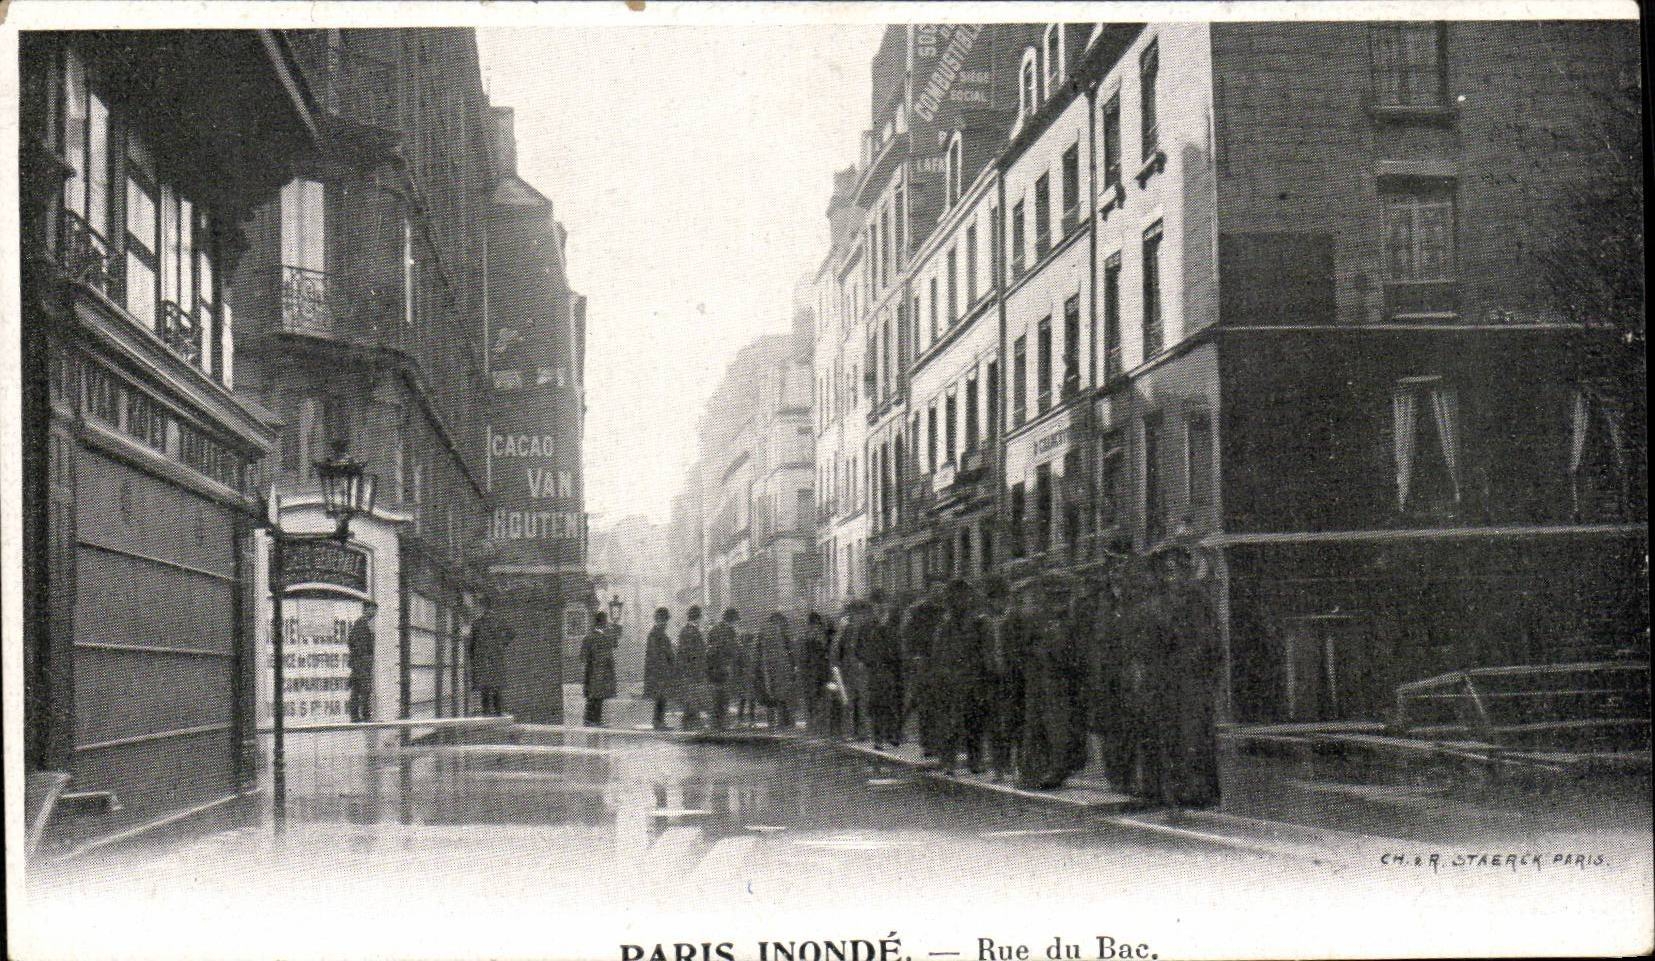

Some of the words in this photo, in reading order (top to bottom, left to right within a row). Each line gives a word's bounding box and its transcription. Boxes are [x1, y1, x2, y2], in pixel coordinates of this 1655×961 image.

[917, 157, 946, 172] LAFA
[492, 434, 554, 457] CACAO
[527, 467, 573, 498] VAN
[493, 508, 578, 539] HOUTEN
